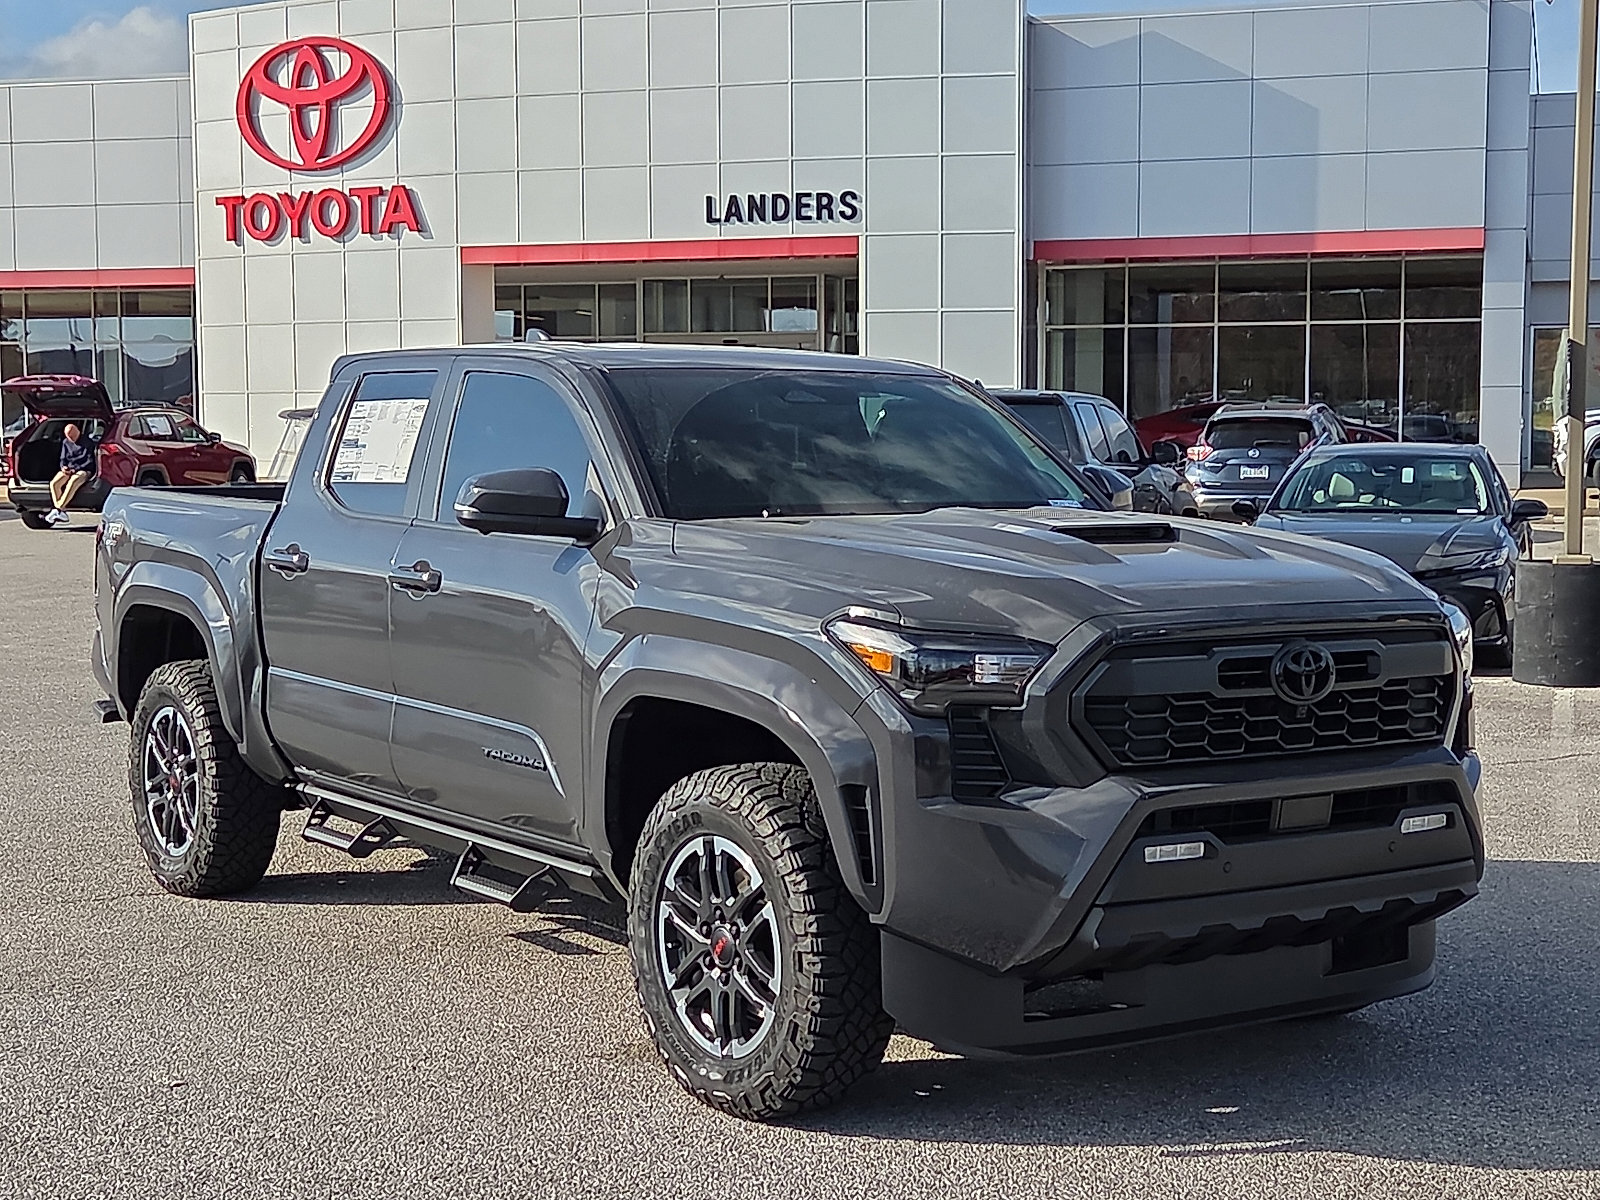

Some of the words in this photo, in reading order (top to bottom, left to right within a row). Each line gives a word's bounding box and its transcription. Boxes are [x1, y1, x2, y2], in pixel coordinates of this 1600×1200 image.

[215, 185, 423, 242] TOYOTA
[705, 191, 860, 223] LANDERS
[481, 746, 547, 771] TACOMA
